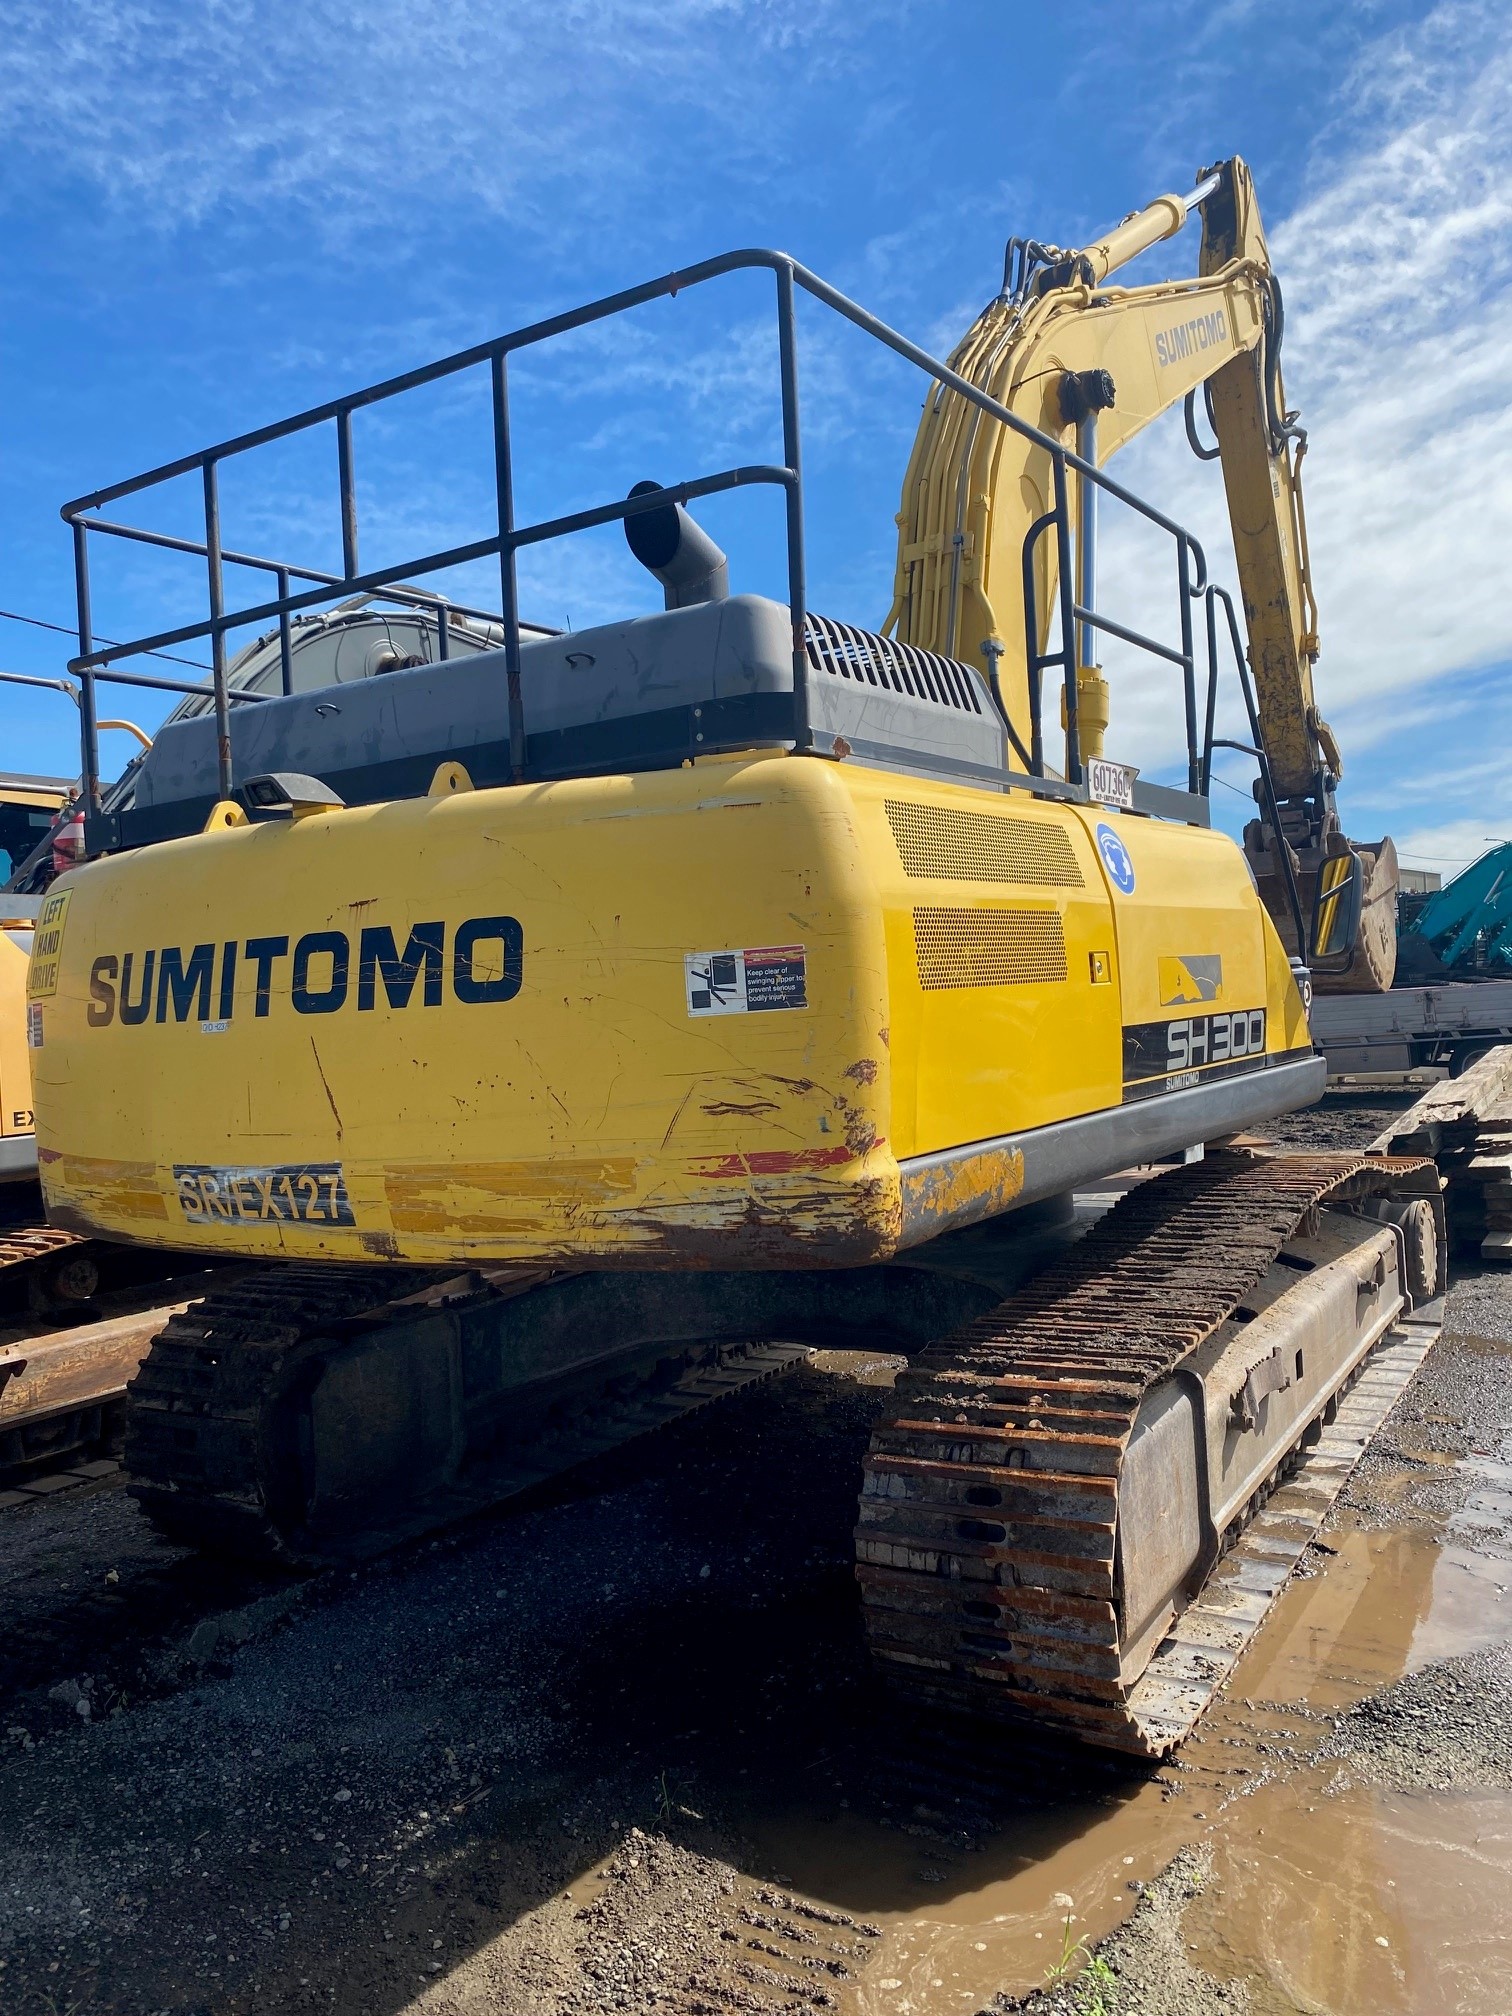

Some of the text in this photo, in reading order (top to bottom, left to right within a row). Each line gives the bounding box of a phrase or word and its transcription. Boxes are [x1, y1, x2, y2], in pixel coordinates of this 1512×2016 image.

[1155, 309, 1227, 368] SUMITOMO
[42, 898, 66, 926] LEFT
[36, 930, 60, 958] HAND
[31, 962, 56, 990] DRIVE
[87, 916, 524, 1027] SUMITOMO
[748, 977, 775, 985] swinging
[748, 986, 771, 994] prevent
[1165, 1071, 1200, 1091] SUMITOMO
[179, 1173, 339, 1220] SR/EX127
